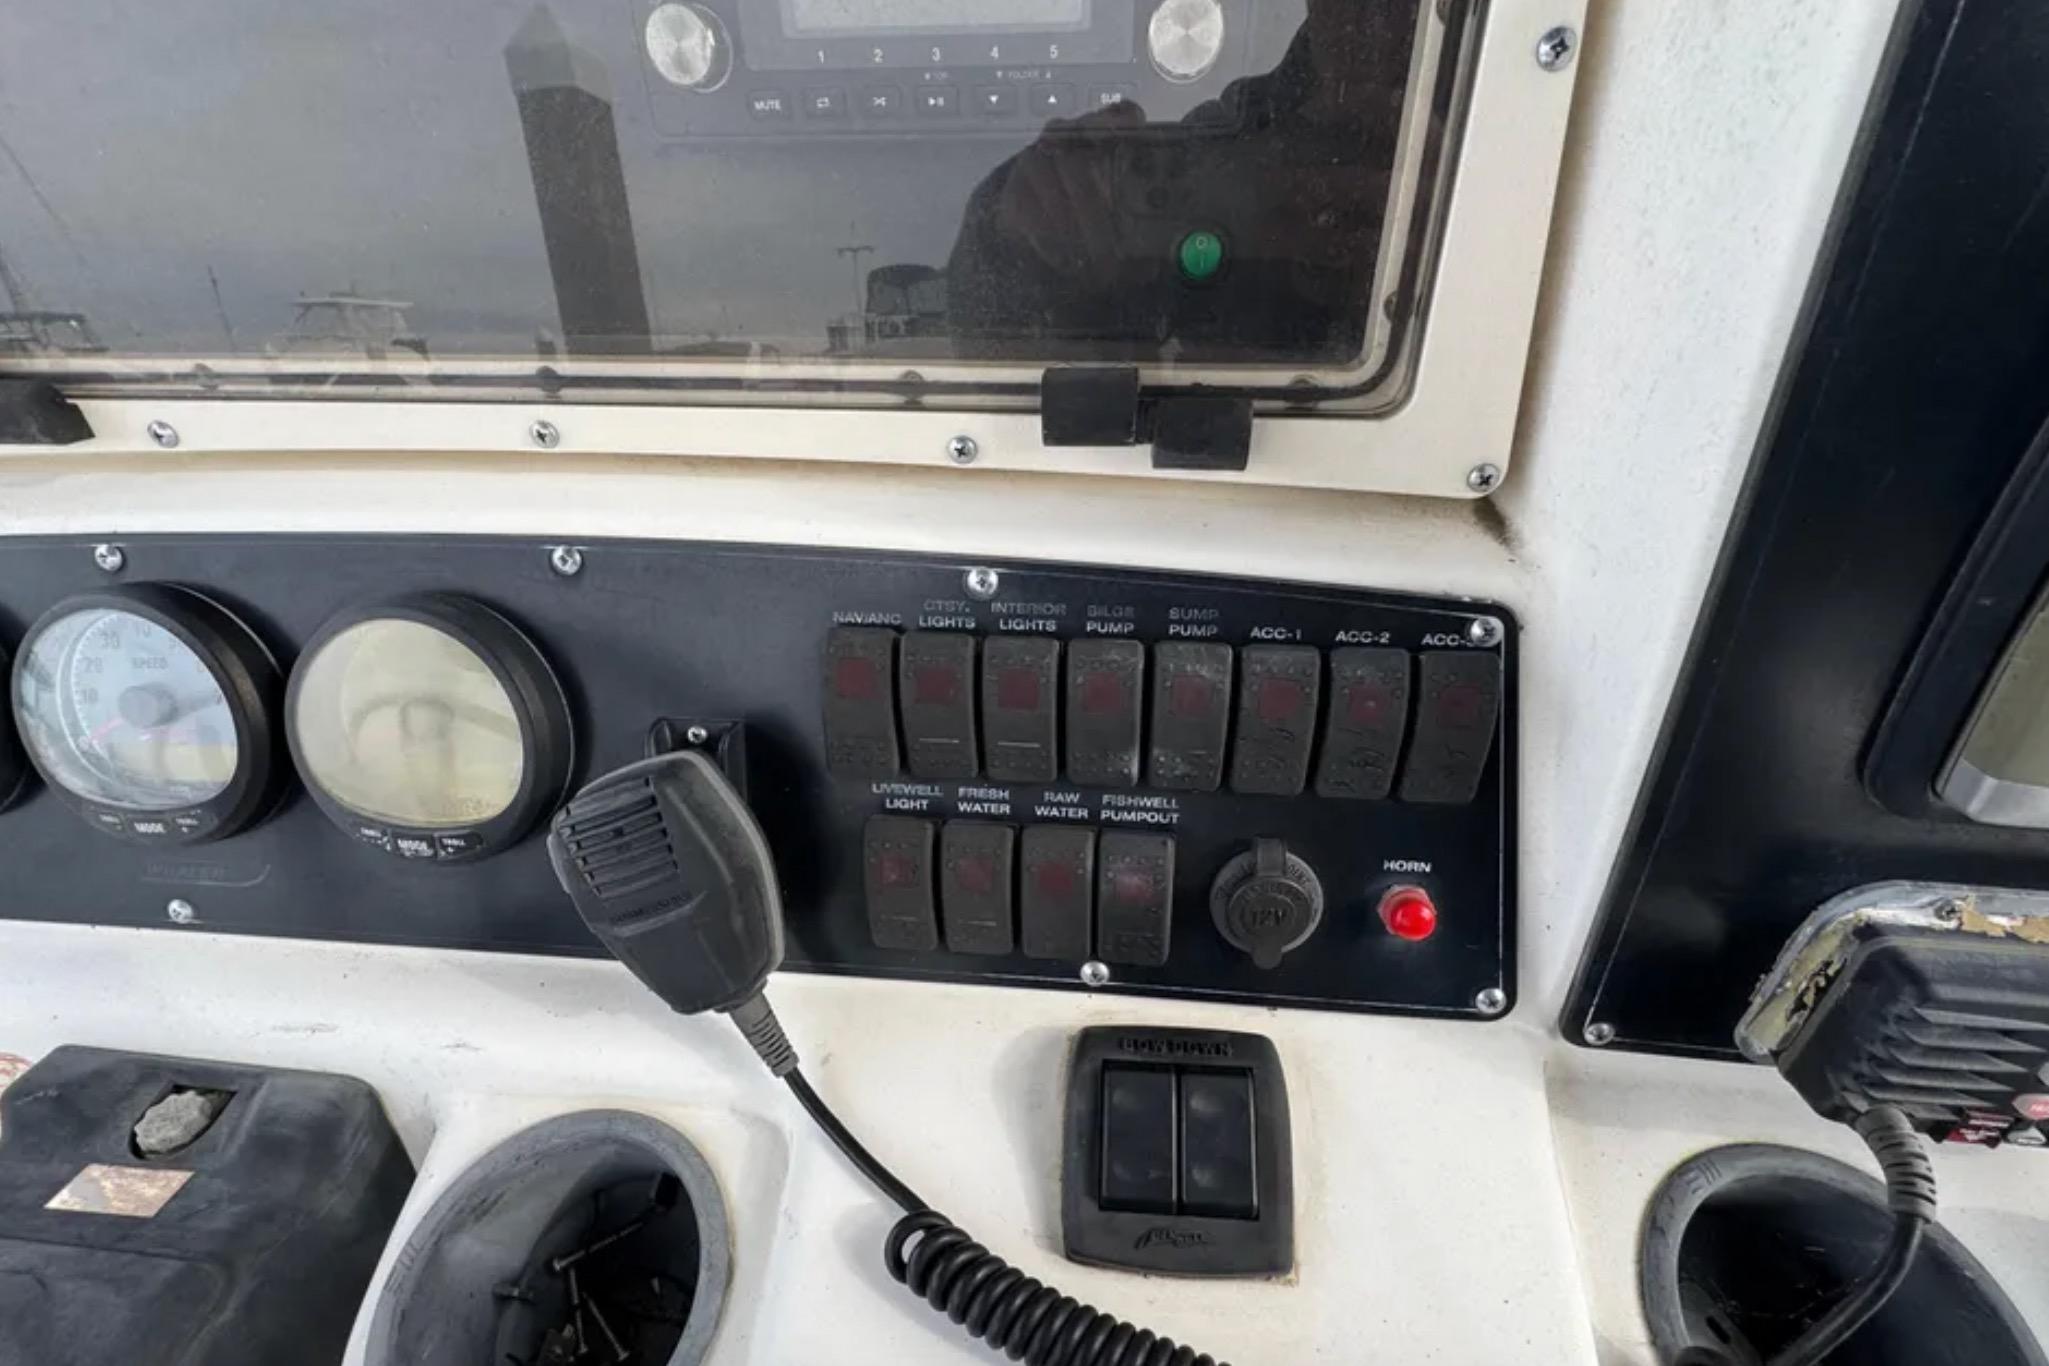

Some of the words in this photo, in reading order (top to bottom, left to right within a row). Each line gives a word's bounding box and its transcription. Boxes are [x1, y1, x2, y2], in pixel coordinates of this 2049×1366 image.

[818, 50, 825, 64] 1
[873, 49, 883, 63] 2
[932, 47, 941, 61] 3
[990, 46, 999, 59] 4
[1050, 45, 1058, 59] 5
[754, 99, 781, 110] MUTE
[923, 600, 970, 612] CTSY.
[990, 602, 1067, 616] INTERIOR
[1087, 605, 1135, 618] BILGE
[1168, 607, 1219, 620] SUMP
[918, 615, 976, 628] LIGHTS
[1000, 618, 1057, 632] LIGHTS
[1086, 620, 1135, 634] PUMP
[1168, 623, 1218, 637] PUMP
[1250, 626, 1301, 640] ACC-1
[1335, 630, 1391, 644] ACC-2
[1421, 633, 1474, 647] ACC-
[131, 656, 169, 669] SPEED
[872, 783, 943, 797] LIVEWELL
[958, 786, 1009, 800] FRESH
[886, 797, 929, 811] LIGHT
[1043, 791, 1080, 804] RAW
[1102, 794, 1179, 809] FISHWELL
[957, 801, 1010, 815] WATER
[1034, 805, 1089, 819] WATER
[1100, 809, 1180, 824] PUMPOUT
[1383, 859, 1431, 872] HORN
